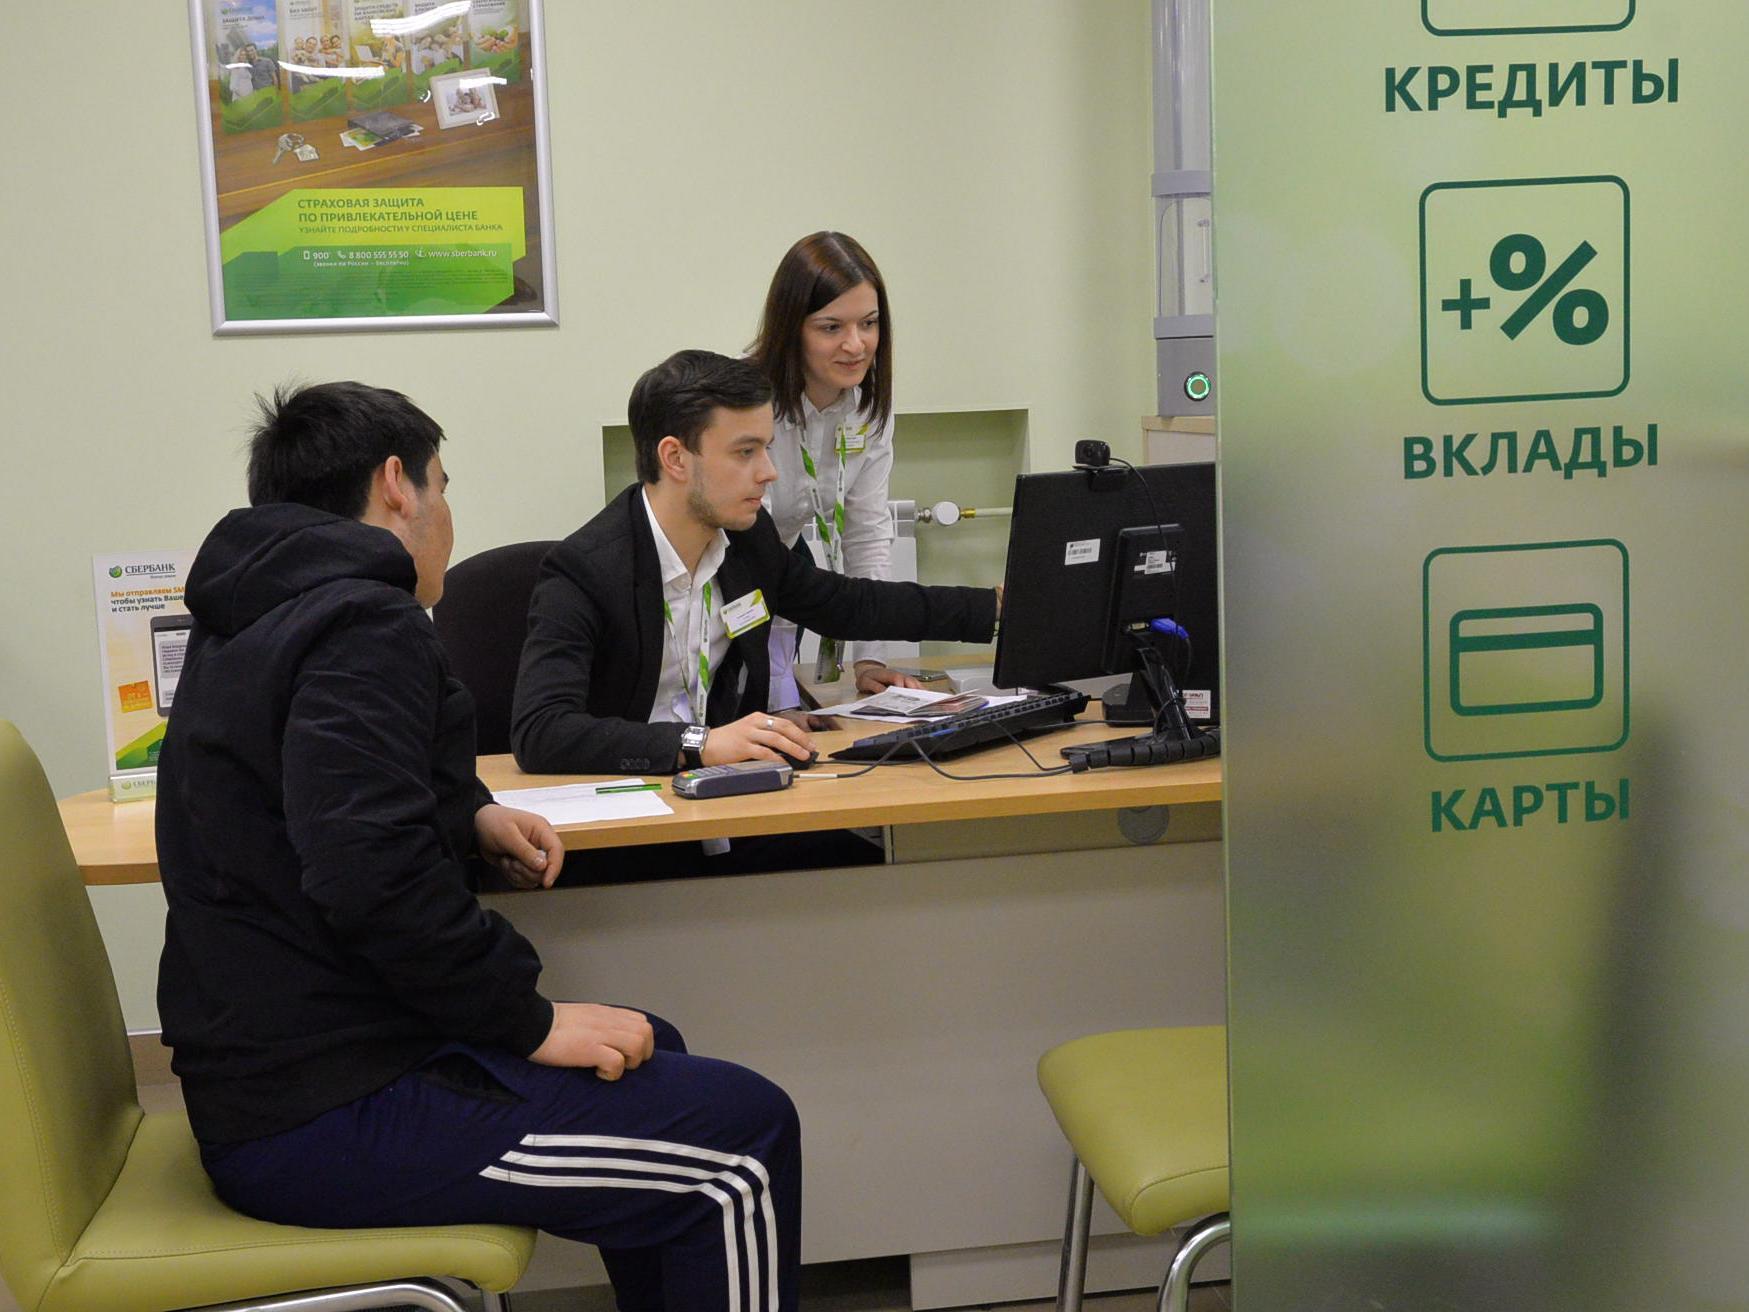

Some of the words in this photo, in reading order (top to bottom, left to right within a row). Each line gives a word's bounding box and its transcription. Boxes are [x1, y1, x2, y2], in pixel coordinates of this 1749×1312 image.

[1384, 58, 1679, 118] КРЕДИТЫ
[298, 199, 370, 209] СТРАХОВАЯ
[373, 198, 424, 209] ЗАЩИТА
[299, 212, 317, 222] ПО
[320, 210, 443, 222] ПРИВЛЕКАТЕЛЬНОЙ
[446, 210, 478, 222] ЦЕНЕ
[299, 225, 337, 234] УЗНАЙТЕ
[338, 225, 403, 234] ПОДРОБНОСТИ
[412, 224, 473, 233] СПЕЦИАЛИСТА
[475, 224, 503, 232] БАНКА
[313, 251, 329, 260] 900
[355, 251, 371, 259] 800
[428, 249, 497, 258] www.sberbank.ru
[1403, 424, 1659, 480] ВКЛАДЫ
[125, 564, 175, 574] СБЕРБАНК
[111, 598, 136, 606] чтобы
[137, 597, 162, 605] узнать
[1431, 778, 1630, 832] КАРТЫ
